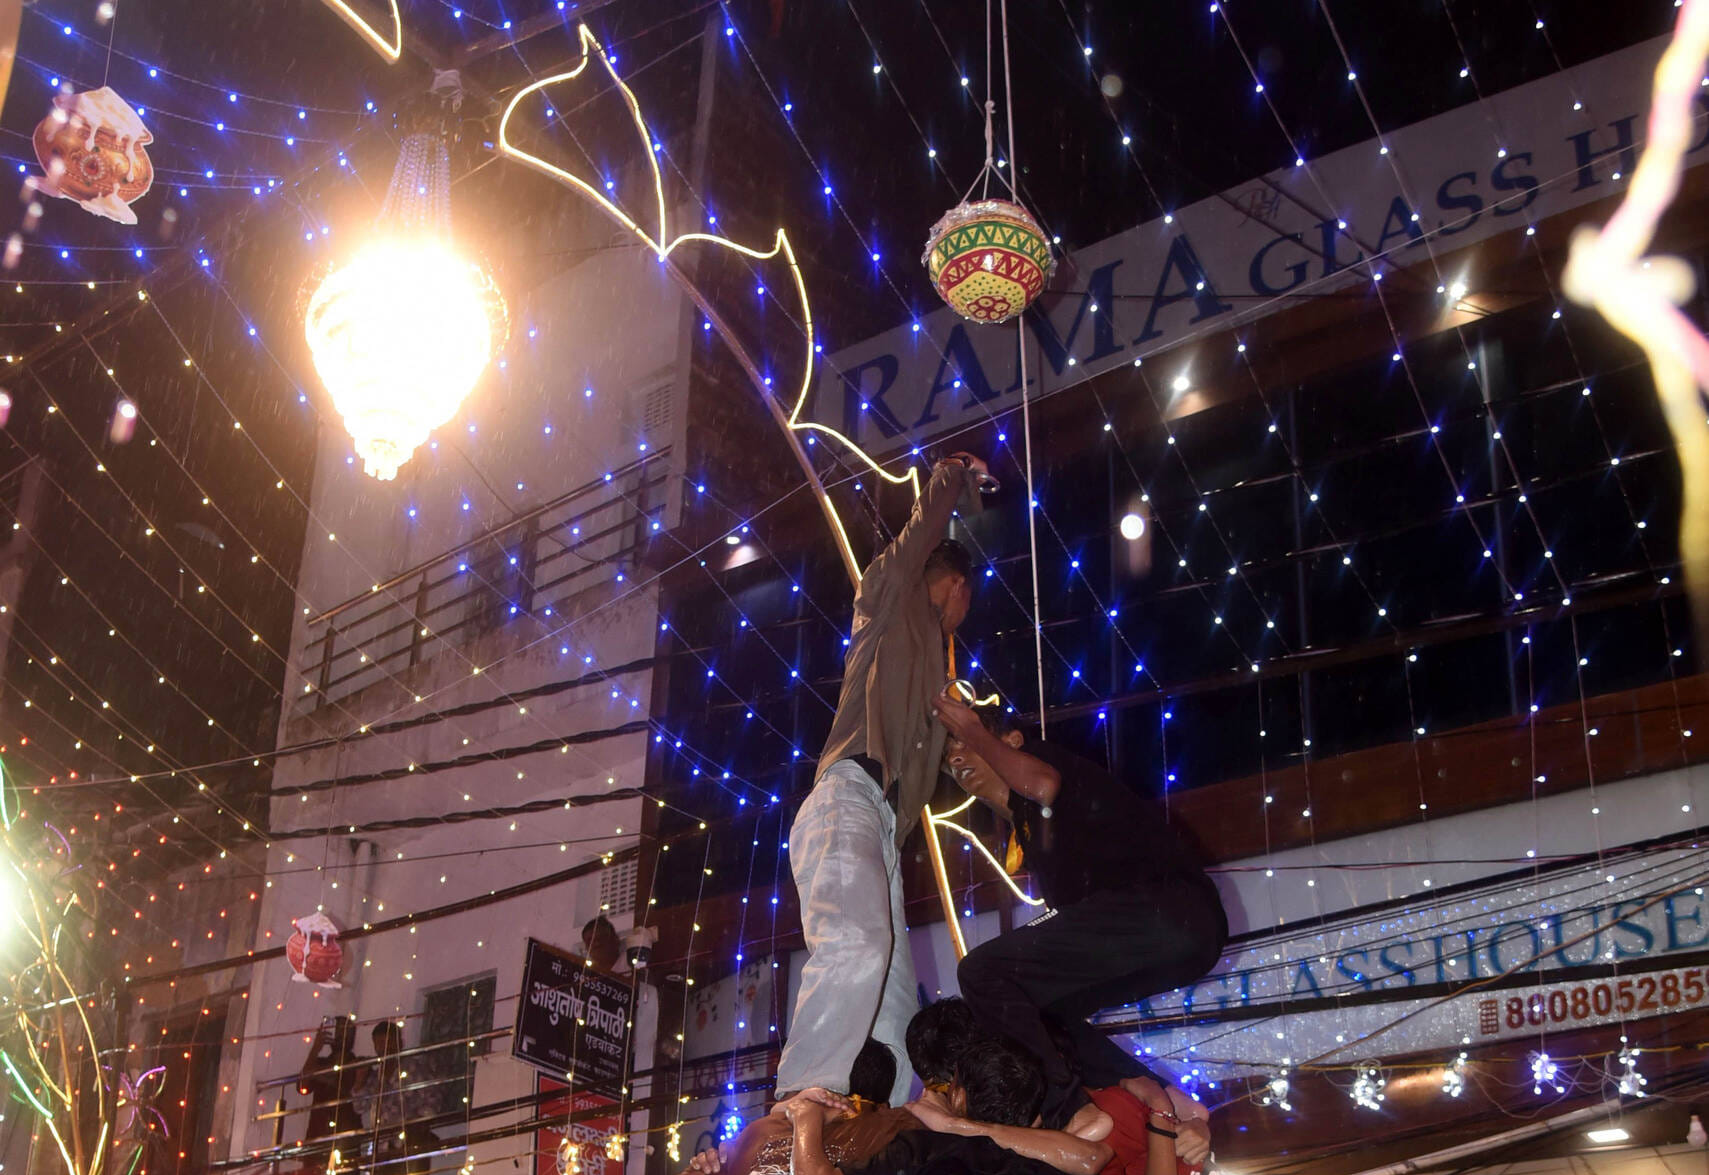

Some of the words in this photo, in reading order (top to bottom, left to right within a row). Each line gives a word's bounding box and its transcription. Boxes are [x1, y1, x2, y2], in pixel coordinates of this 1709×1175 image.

[841, 236, 1233, 445] RAMA
[1249, 151, 1540, 298] GLASS
[530, 981, 585, 1026] आशुतोष
[586, 995, 625, 1040] त्रिपाठी
[1506, 968, 1709, 1029] 880805285
